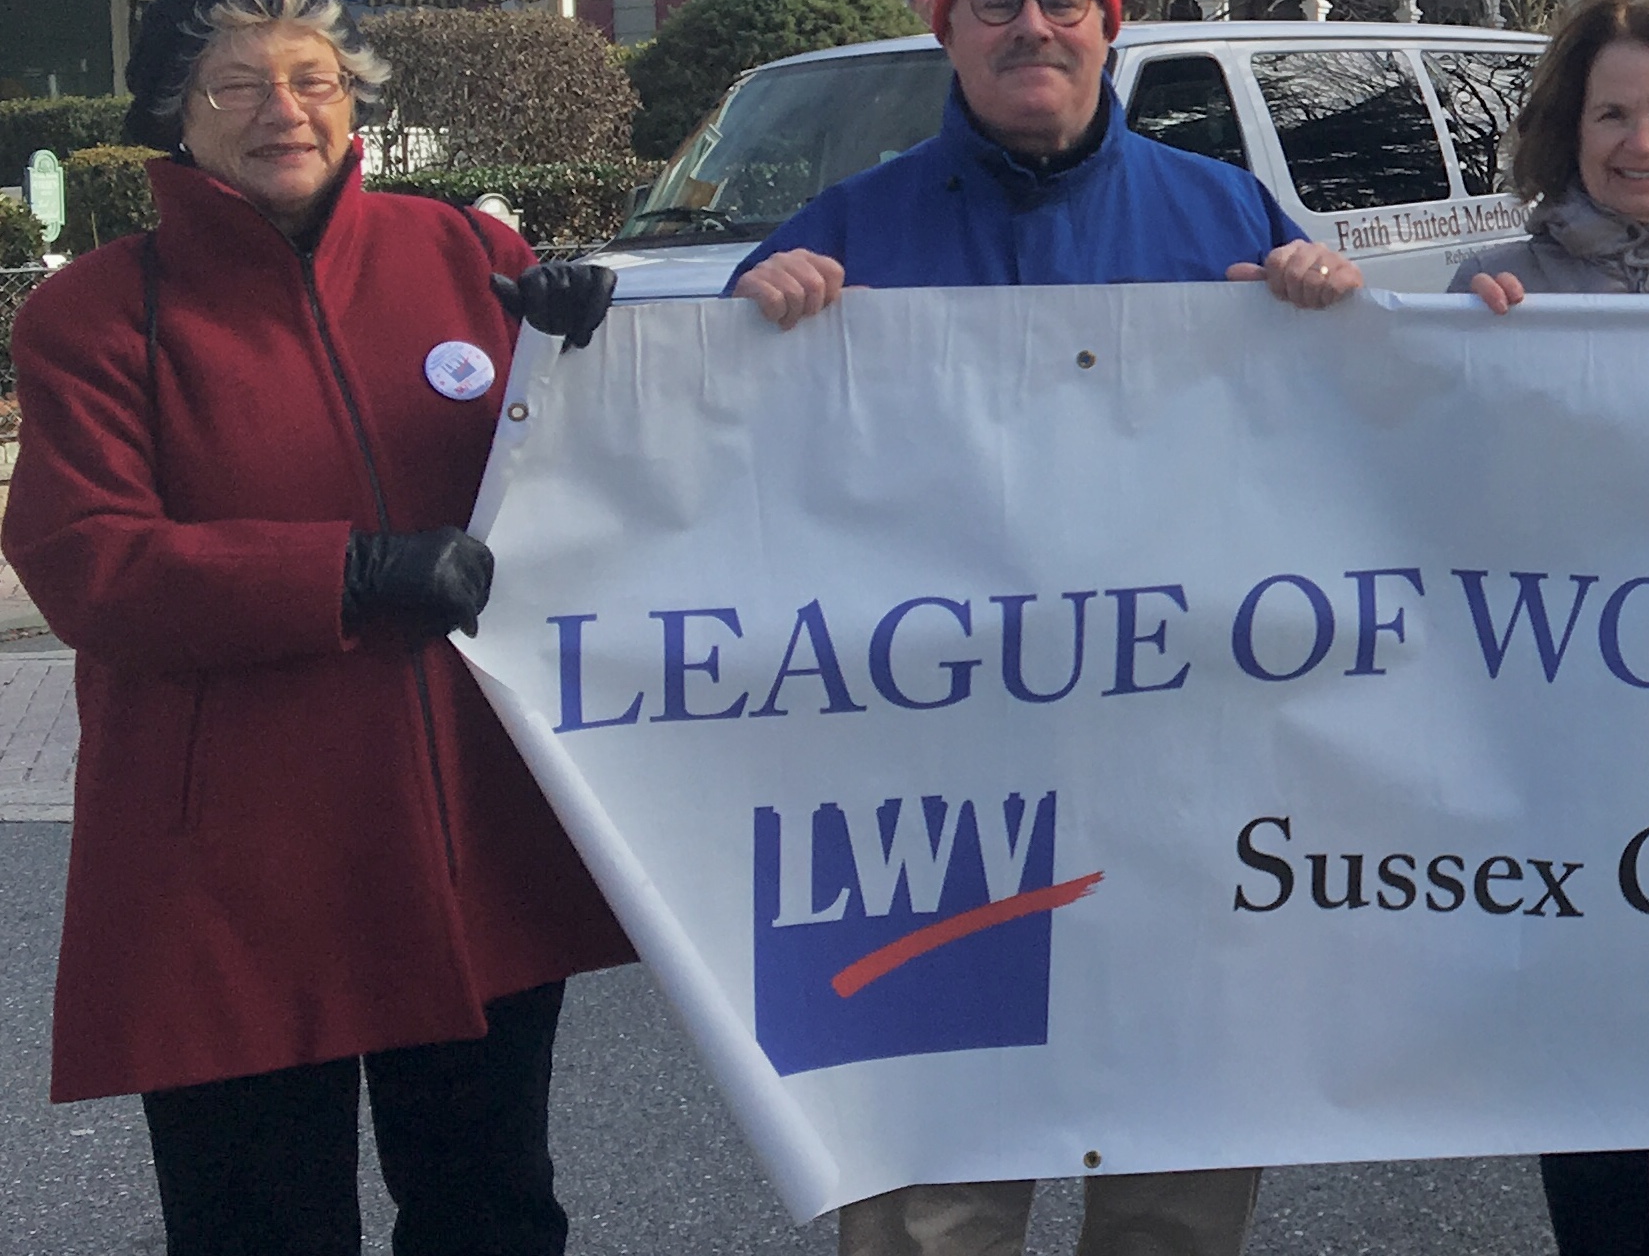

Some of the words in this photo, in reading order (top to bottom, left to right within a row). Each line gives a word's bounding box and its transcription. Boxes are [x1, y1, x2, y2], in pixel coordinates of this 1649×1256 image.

[1335, 216, 1391, 252] Faith
[1393, 206, 1461, 243] United
[546, 585, 1190, 733] LEAGUE
[1232, 568, 1425, 681] OF
[770, 791, 1052, 928] LWV
[1234, 817, 1584, 917] Sussex
